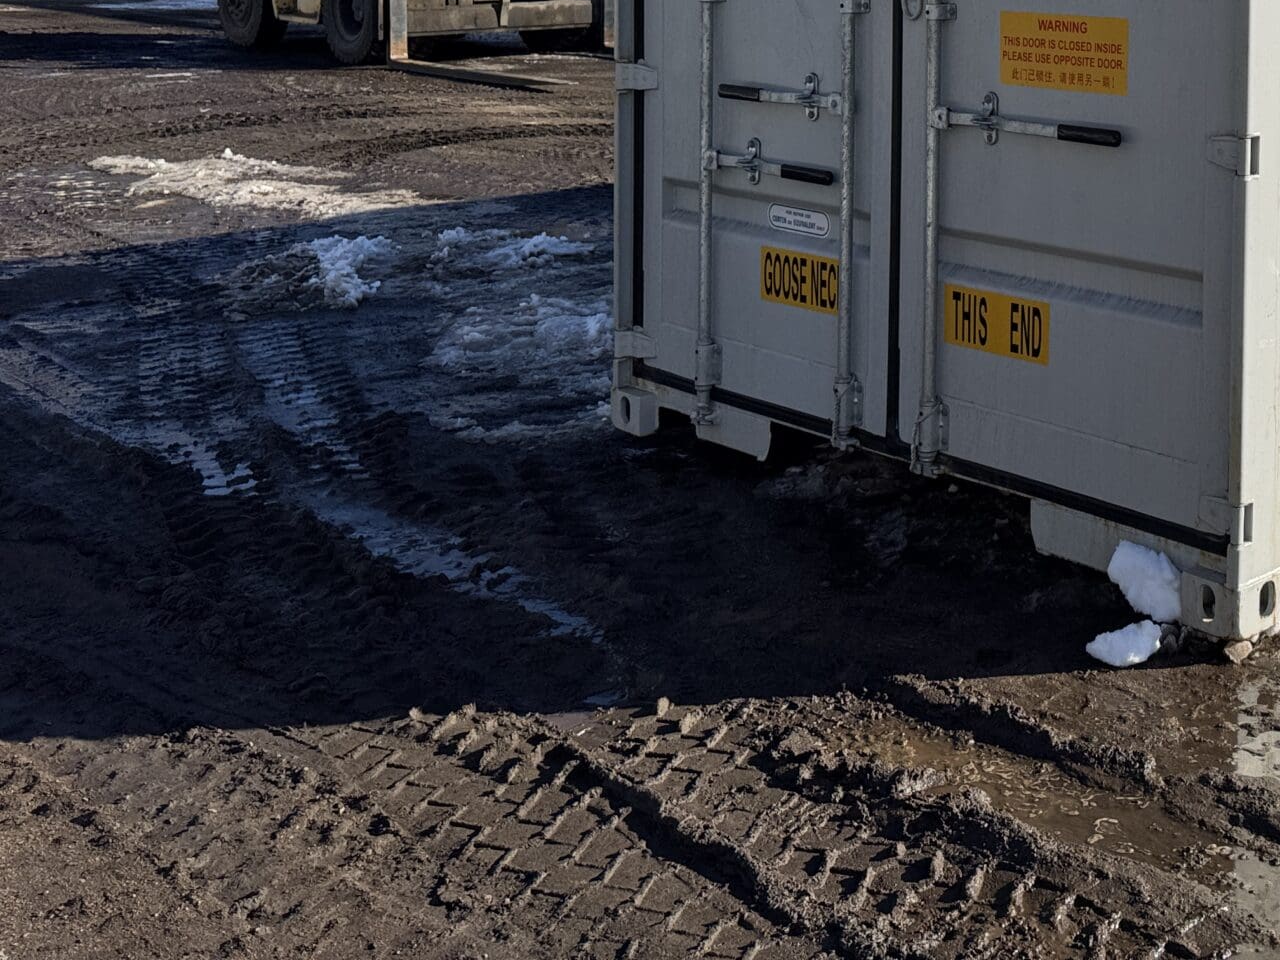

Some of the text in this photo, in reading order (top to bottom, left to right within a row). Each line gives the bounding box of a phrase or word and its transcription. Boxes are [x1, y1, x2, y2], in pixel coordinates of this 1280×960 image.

[1038, 19, 1088, 34] WARNING
[1003, 36, 1020, 47] THIS
[1022, 37, 1046, 48] DOOR
[1048, 40, 1056, 49] IS
[1058, 40, 1092, 52] CLOSED
[1002, 50, 1032, 62] PLEASE
[1035, 53, 1051, 64] USE
[1053, 54, 1095, 68] OPPOSITE
[764, 251, 840, 311] GOOSE NEC
[952, 290, 1042, 358] THIS END
